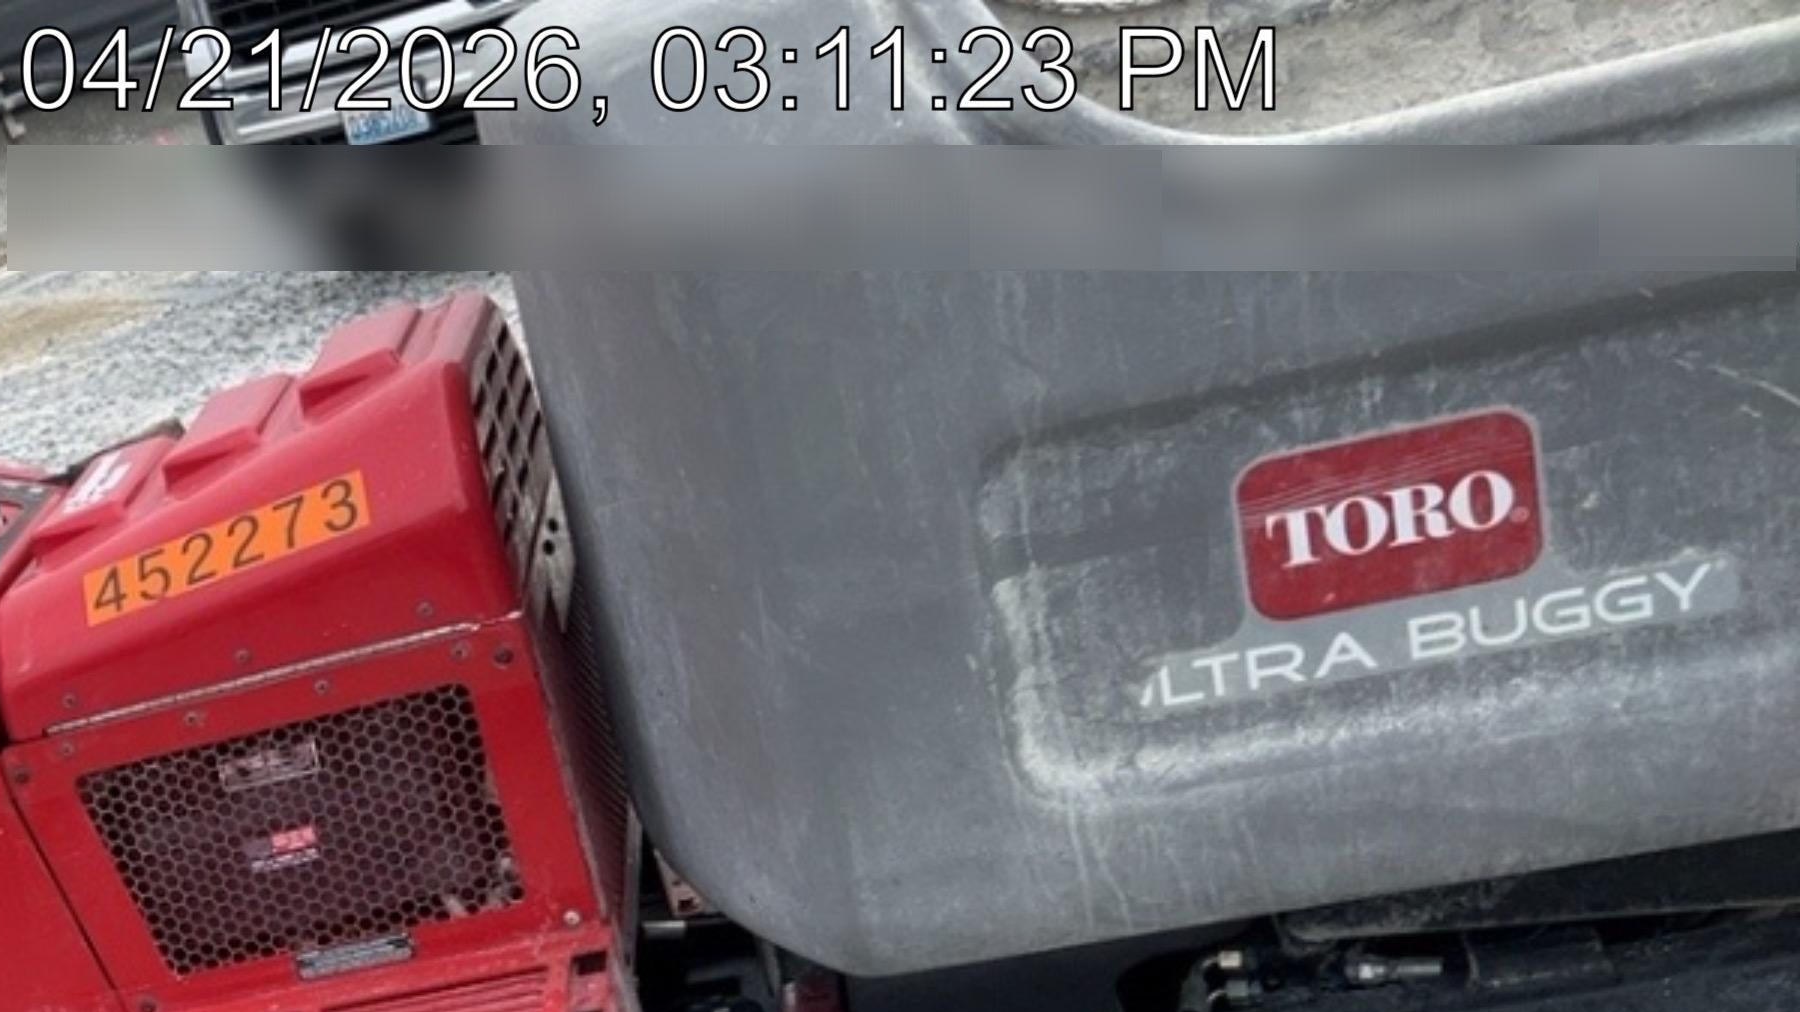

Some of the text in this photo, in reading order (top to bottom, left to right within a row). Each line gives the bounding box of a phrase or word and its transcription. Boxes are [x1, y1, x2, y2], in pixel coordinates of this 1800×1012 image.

[93, 478, 359, 612] 452273
[1266, 469, 1515, 568] TORO
[1407, 562, 1713, 661] BUGGY
